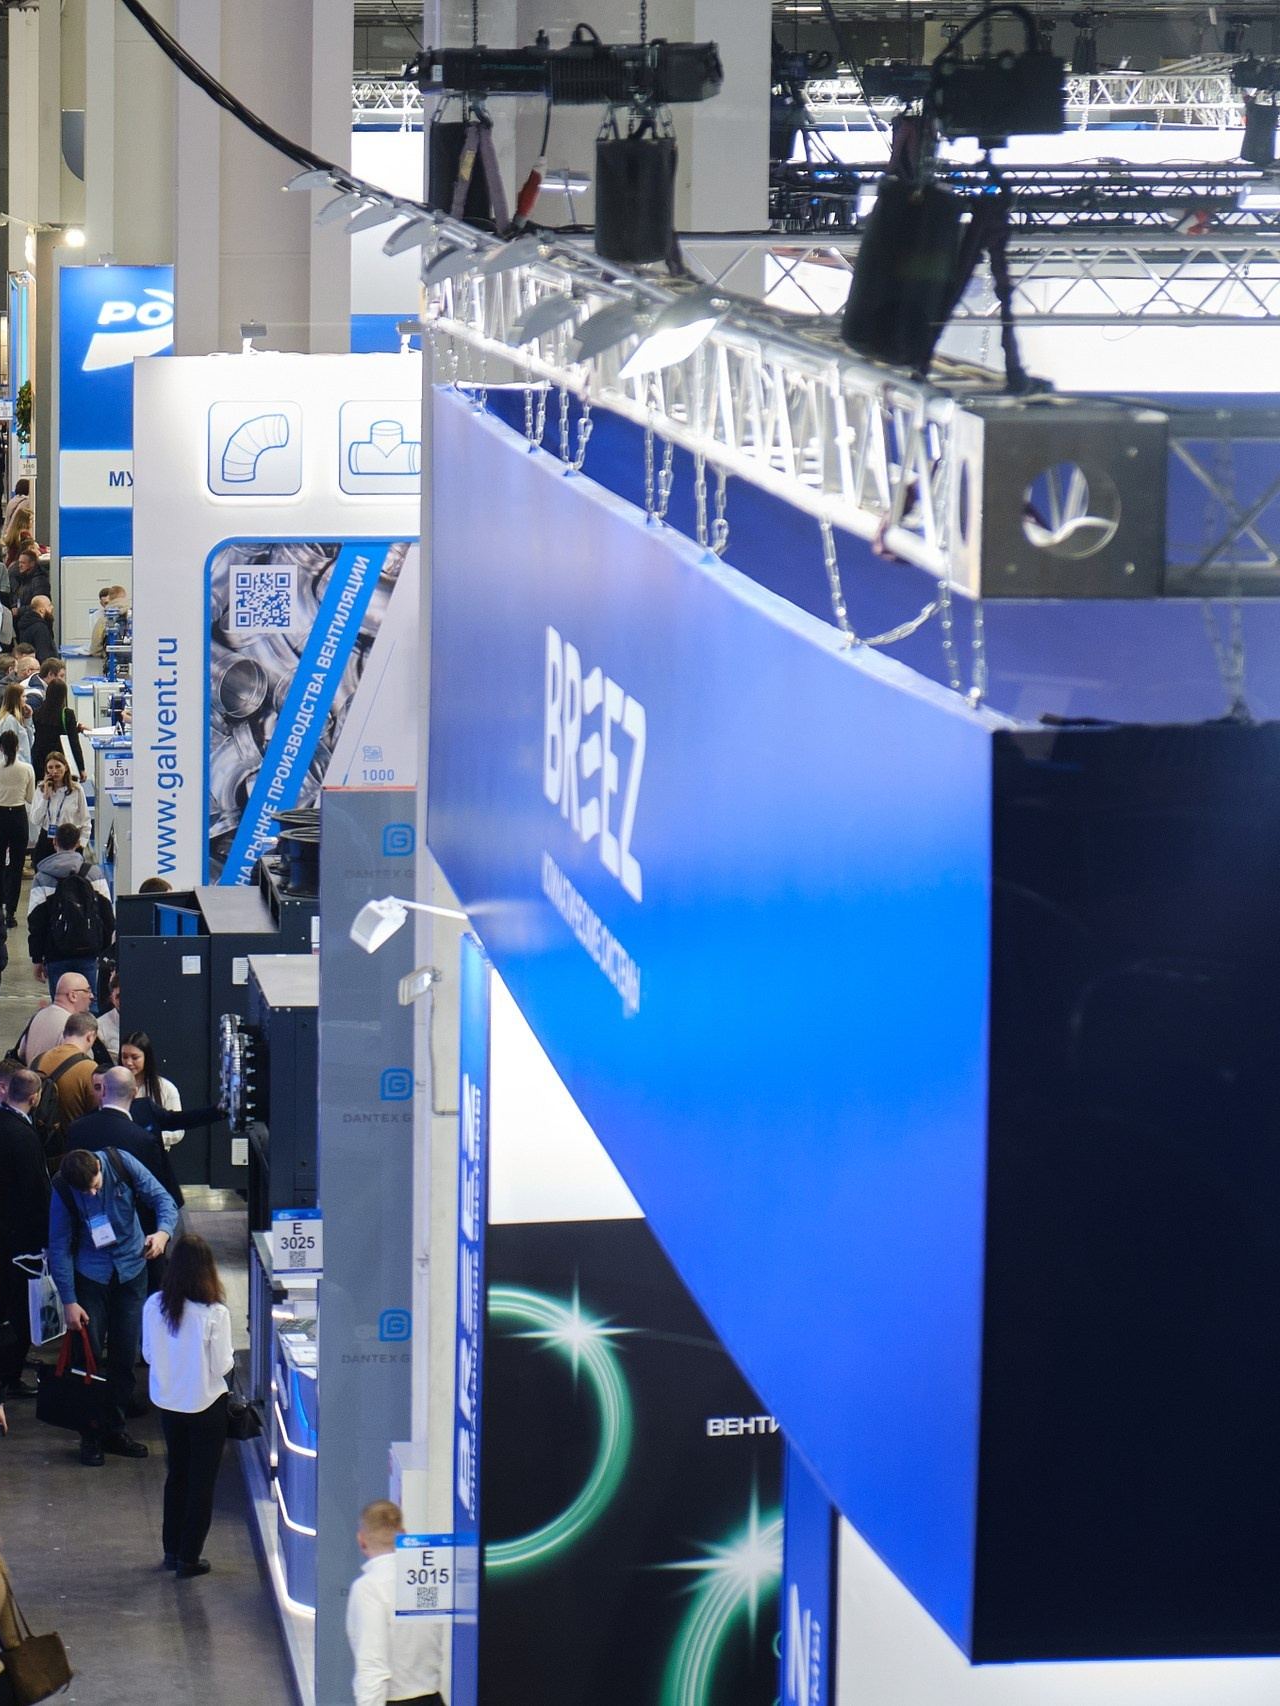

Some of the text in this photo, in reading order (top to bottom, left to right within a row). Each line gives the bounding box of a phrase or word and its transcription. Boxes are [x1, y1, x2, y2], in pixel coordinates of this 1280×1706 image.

[235, 555, 370, 887] НА РЫНКЕ ПРОИЗВОДСТВА ВЕНТИЛЯЦИИ
[150, 637, 184, 875] www.galvent.ru
[543, 625, 648, 905] BREEZ
[109, 768, 129, 776] 3031
[362, 769, 395, 781] 1000
[342, 1112, 394, 1123] DANTEX
[293, 1222, 303, 1235] E
[280, 1236, 315, 1249] 3025
[341, 1354, 394, 1364] DANTEX
[422, 1550, 434, 1566] E
[406, 1568, 449, 1585] 3015
